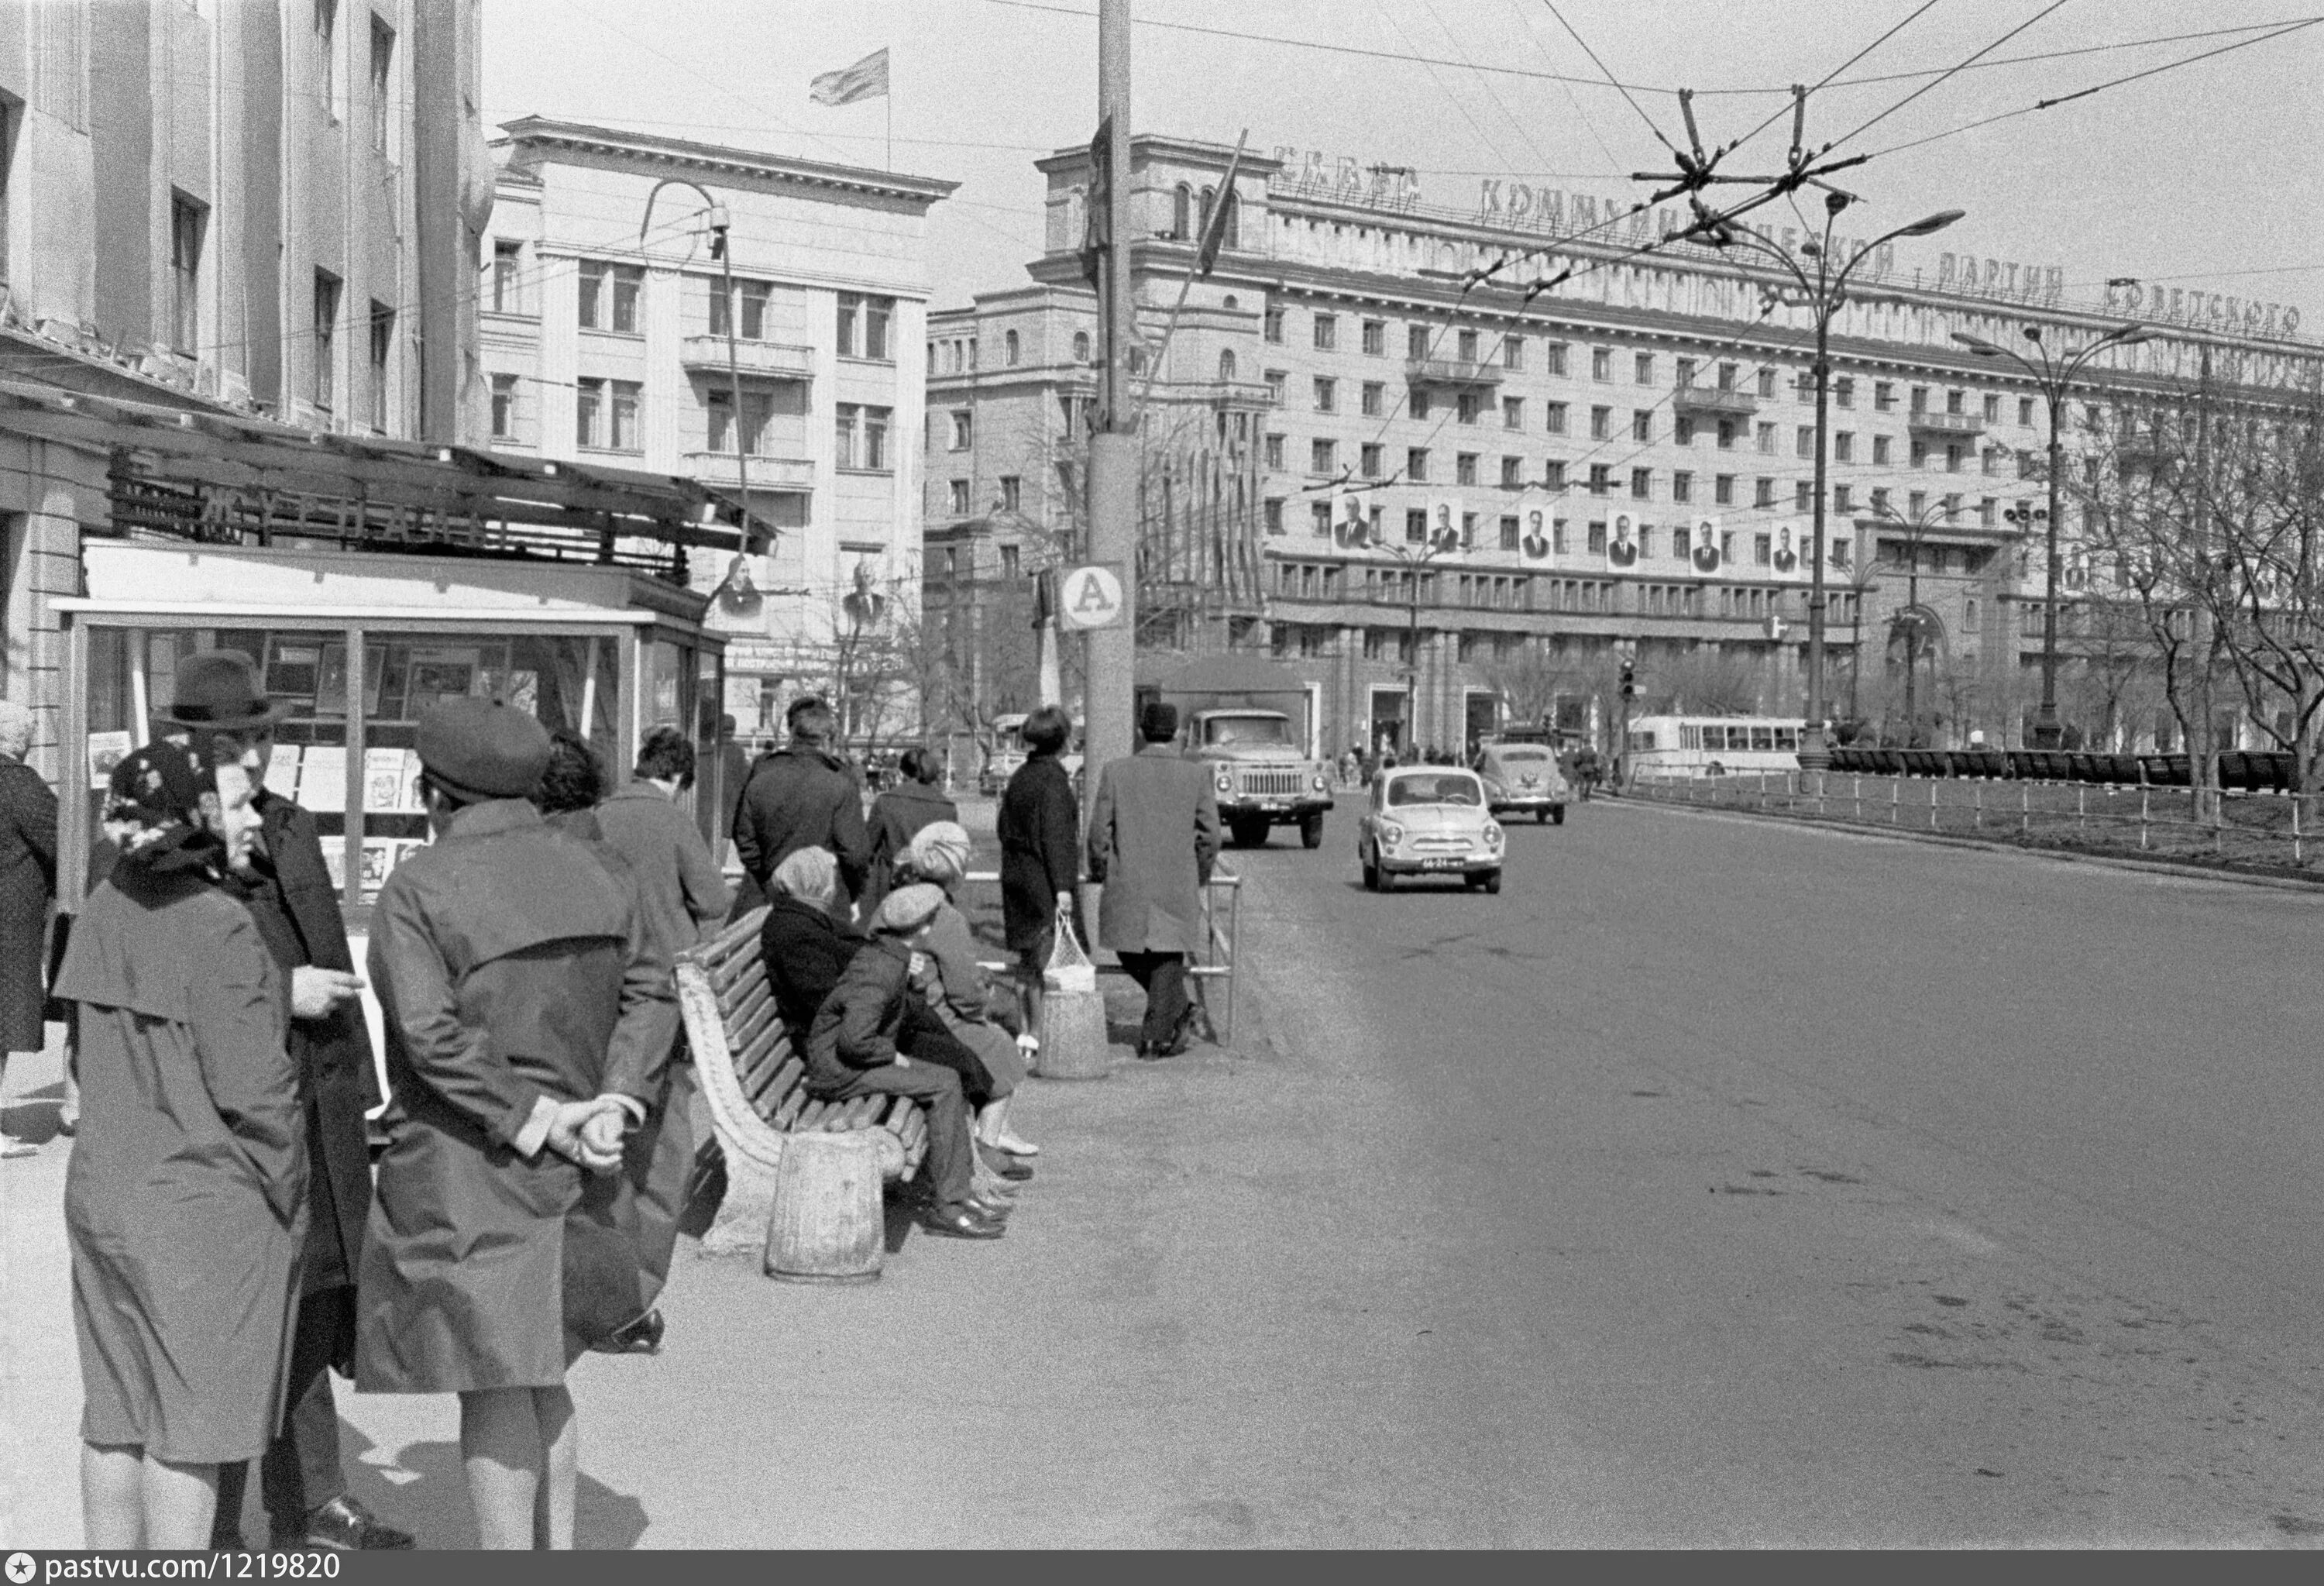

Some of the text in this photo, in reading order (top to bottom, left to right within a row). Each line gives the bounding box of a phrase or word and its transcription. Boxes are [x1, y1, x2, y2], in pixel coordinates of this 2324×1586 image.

[1939, 252, 2063, 294] ПАРТИИ
[2106, 280, 2299, 332] СОВЕТСКОГО
[1073, 573, 1115, 612] А
